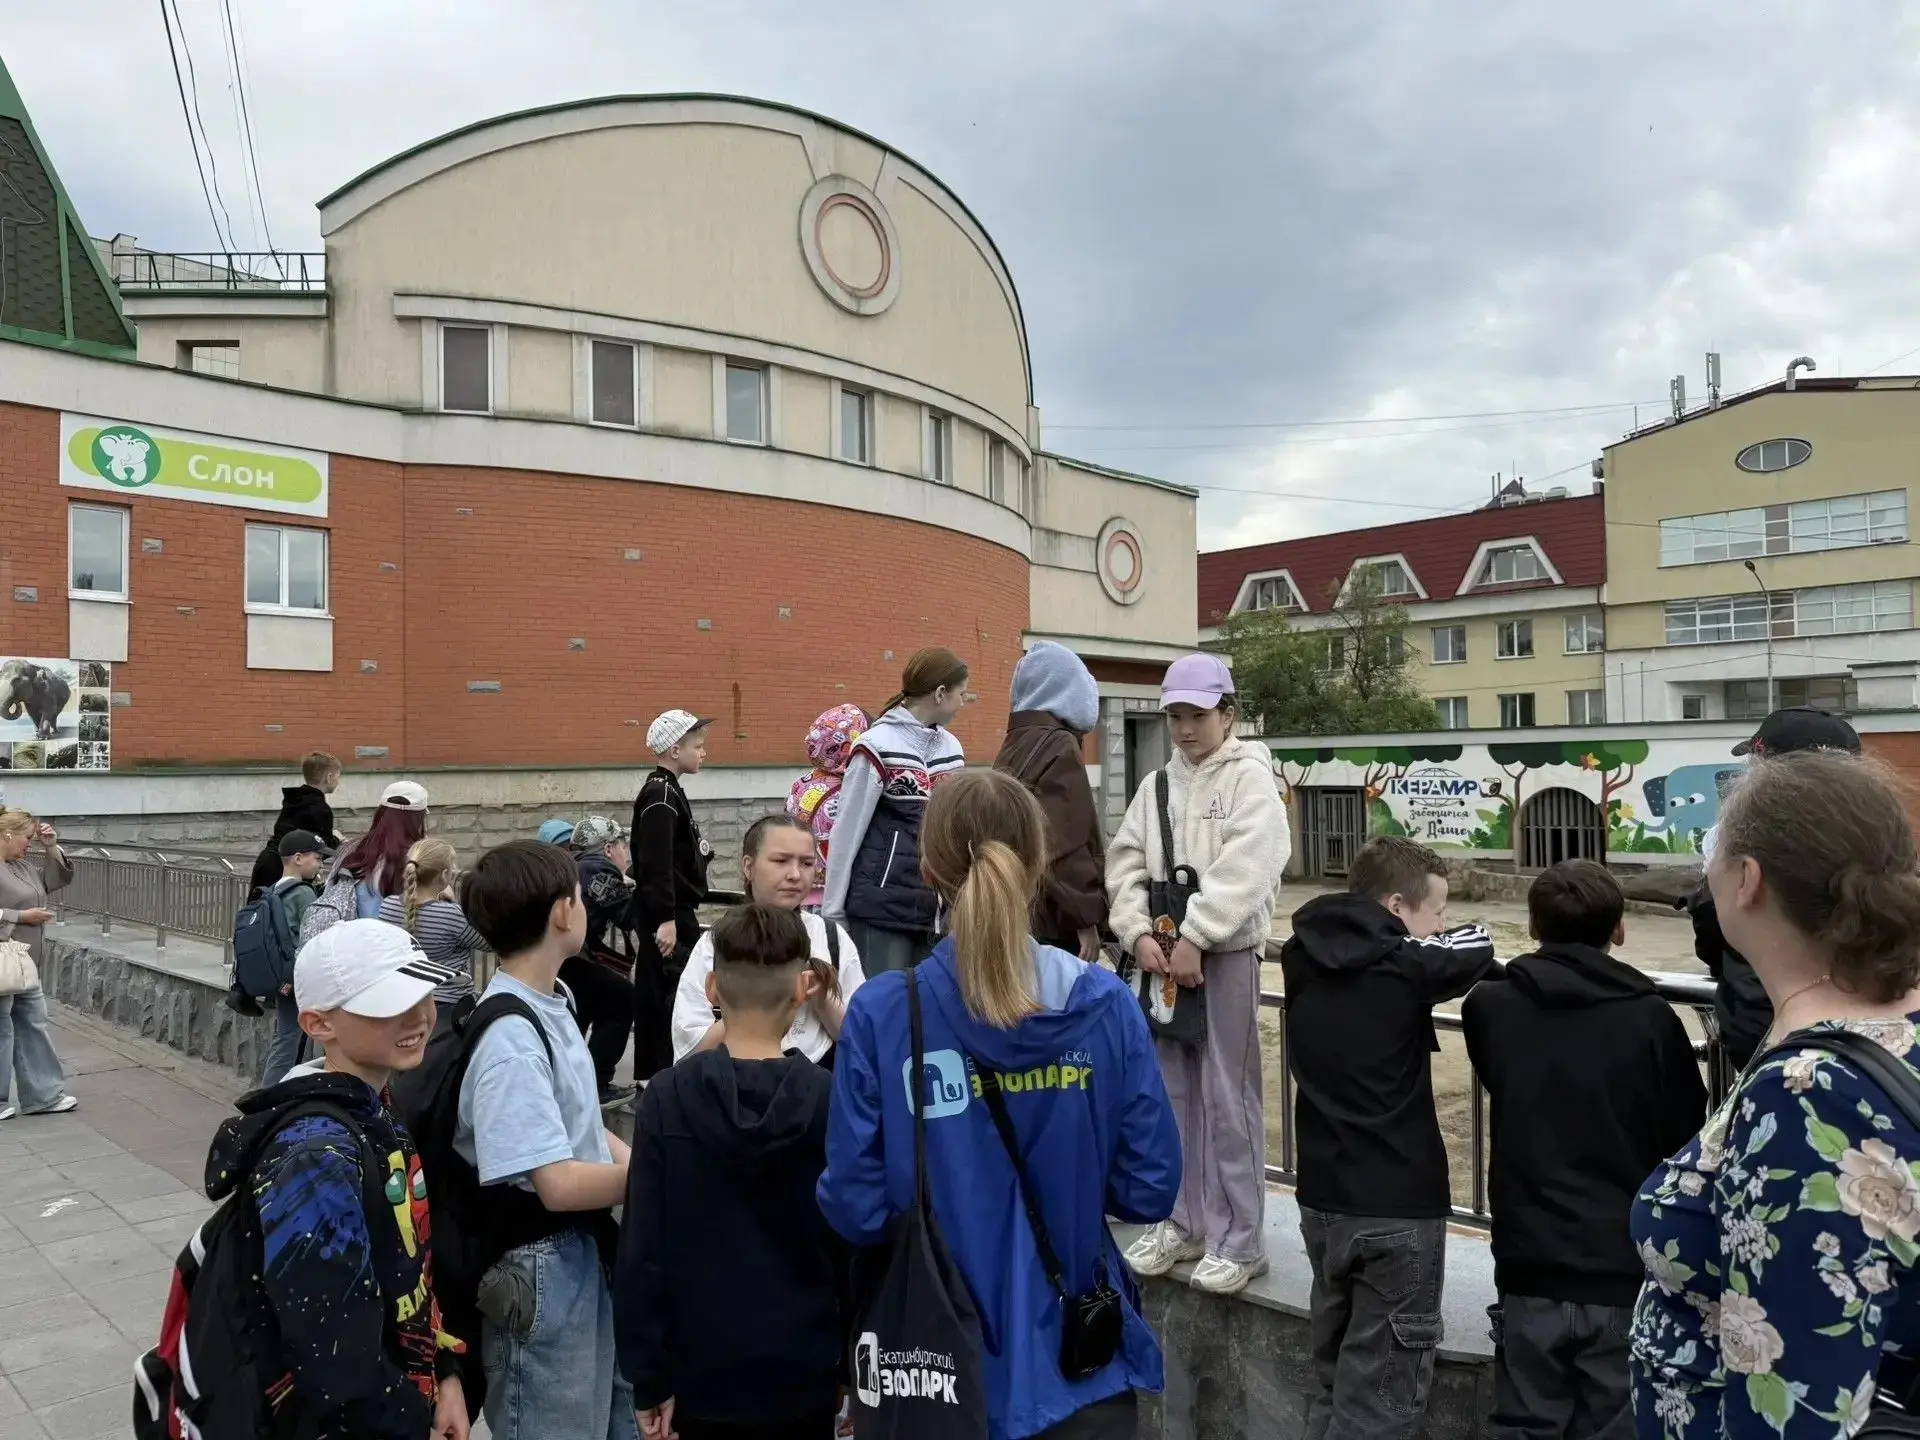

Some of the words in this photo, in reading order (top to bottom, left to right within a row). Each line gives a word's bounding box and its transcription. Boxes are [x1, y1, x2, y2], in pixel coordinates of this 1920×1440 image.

[188, 454, 274, 489] Слон
[1391, 779, 1478, 795] КЕРАМИР
[1409, 807, 1470, 820] заботится
[1426, 820, 1468, 839] Даше
